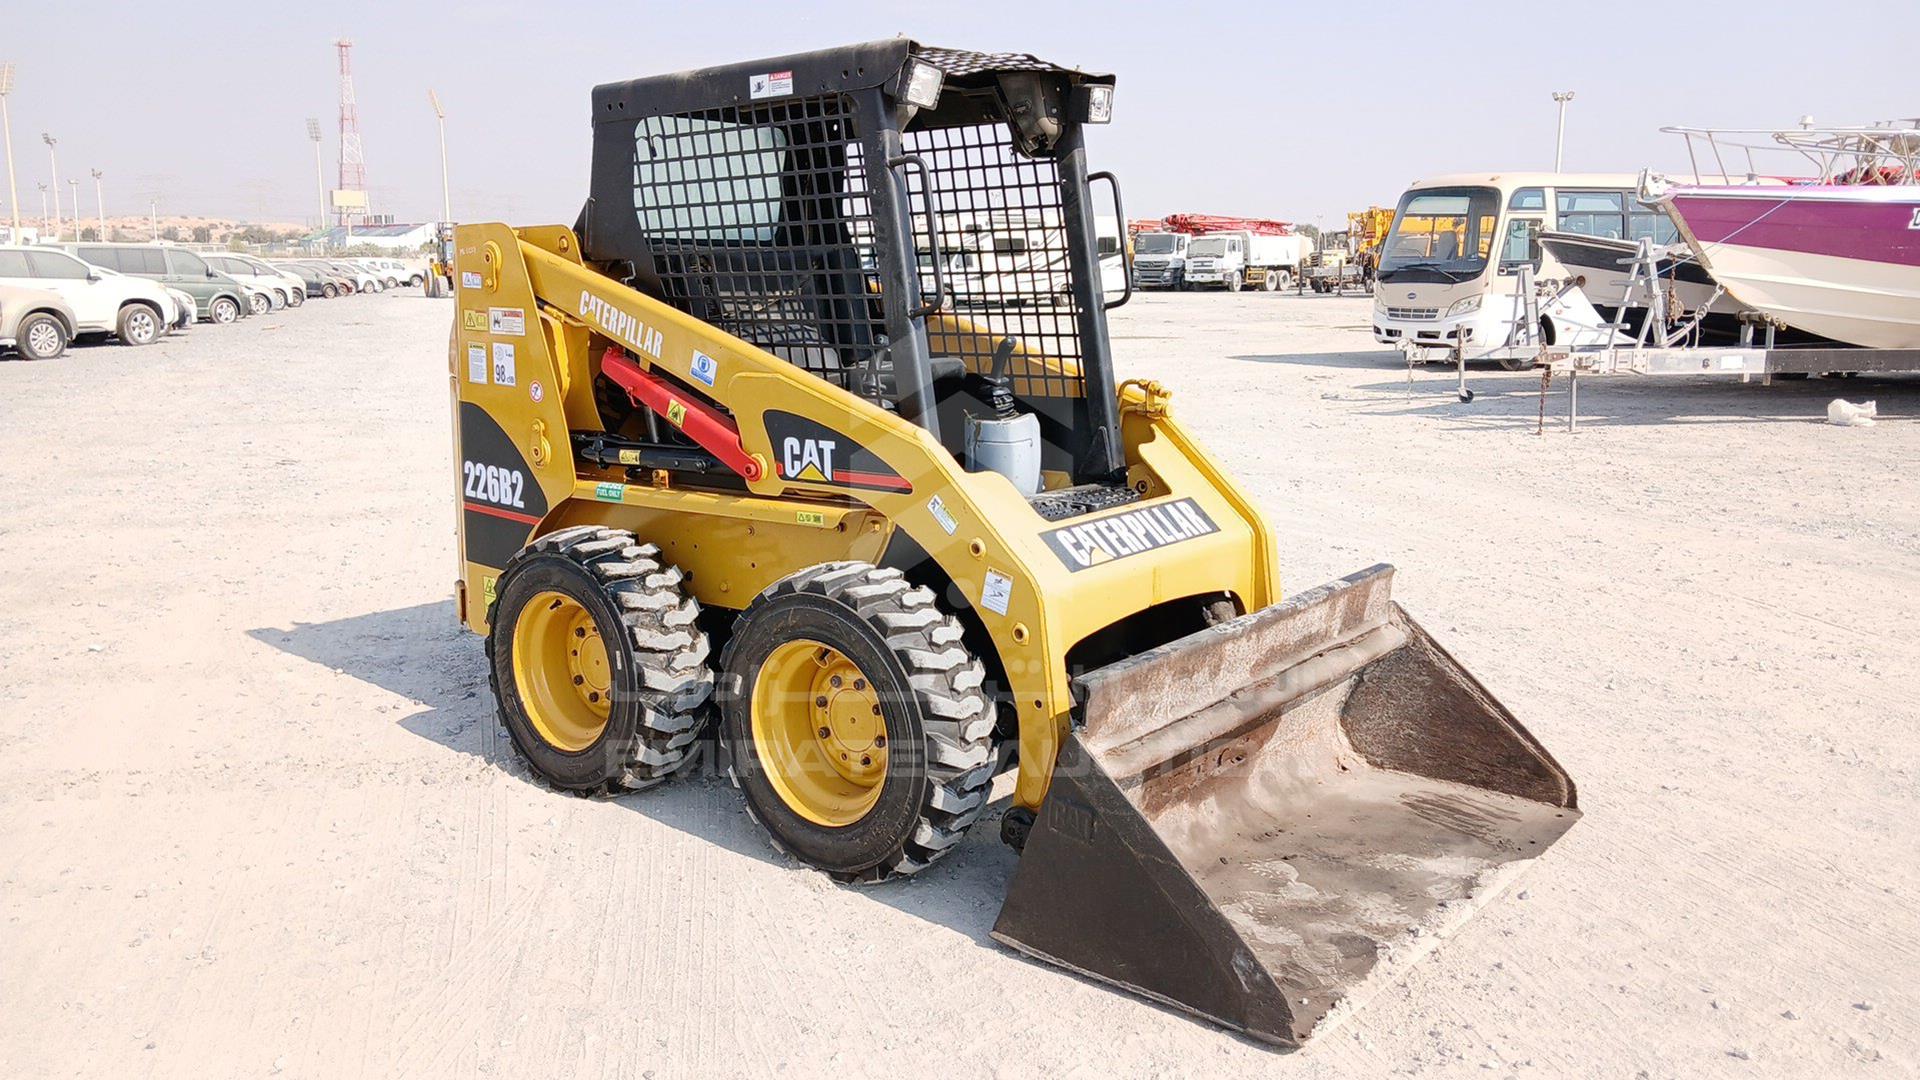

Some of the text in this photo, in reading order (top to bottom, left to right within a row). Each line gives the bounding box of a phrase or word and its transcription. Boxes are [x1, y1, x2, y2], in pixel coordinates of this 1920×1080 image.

[579, 290, 663, 358] CATERPILLAR
[495, 364, 506, 382] 98
[784, 436, 836, 482] CAT
[464, 461, 524, 508] 226B2
[1056, 501, 1212, 566] CATERPILLAR
